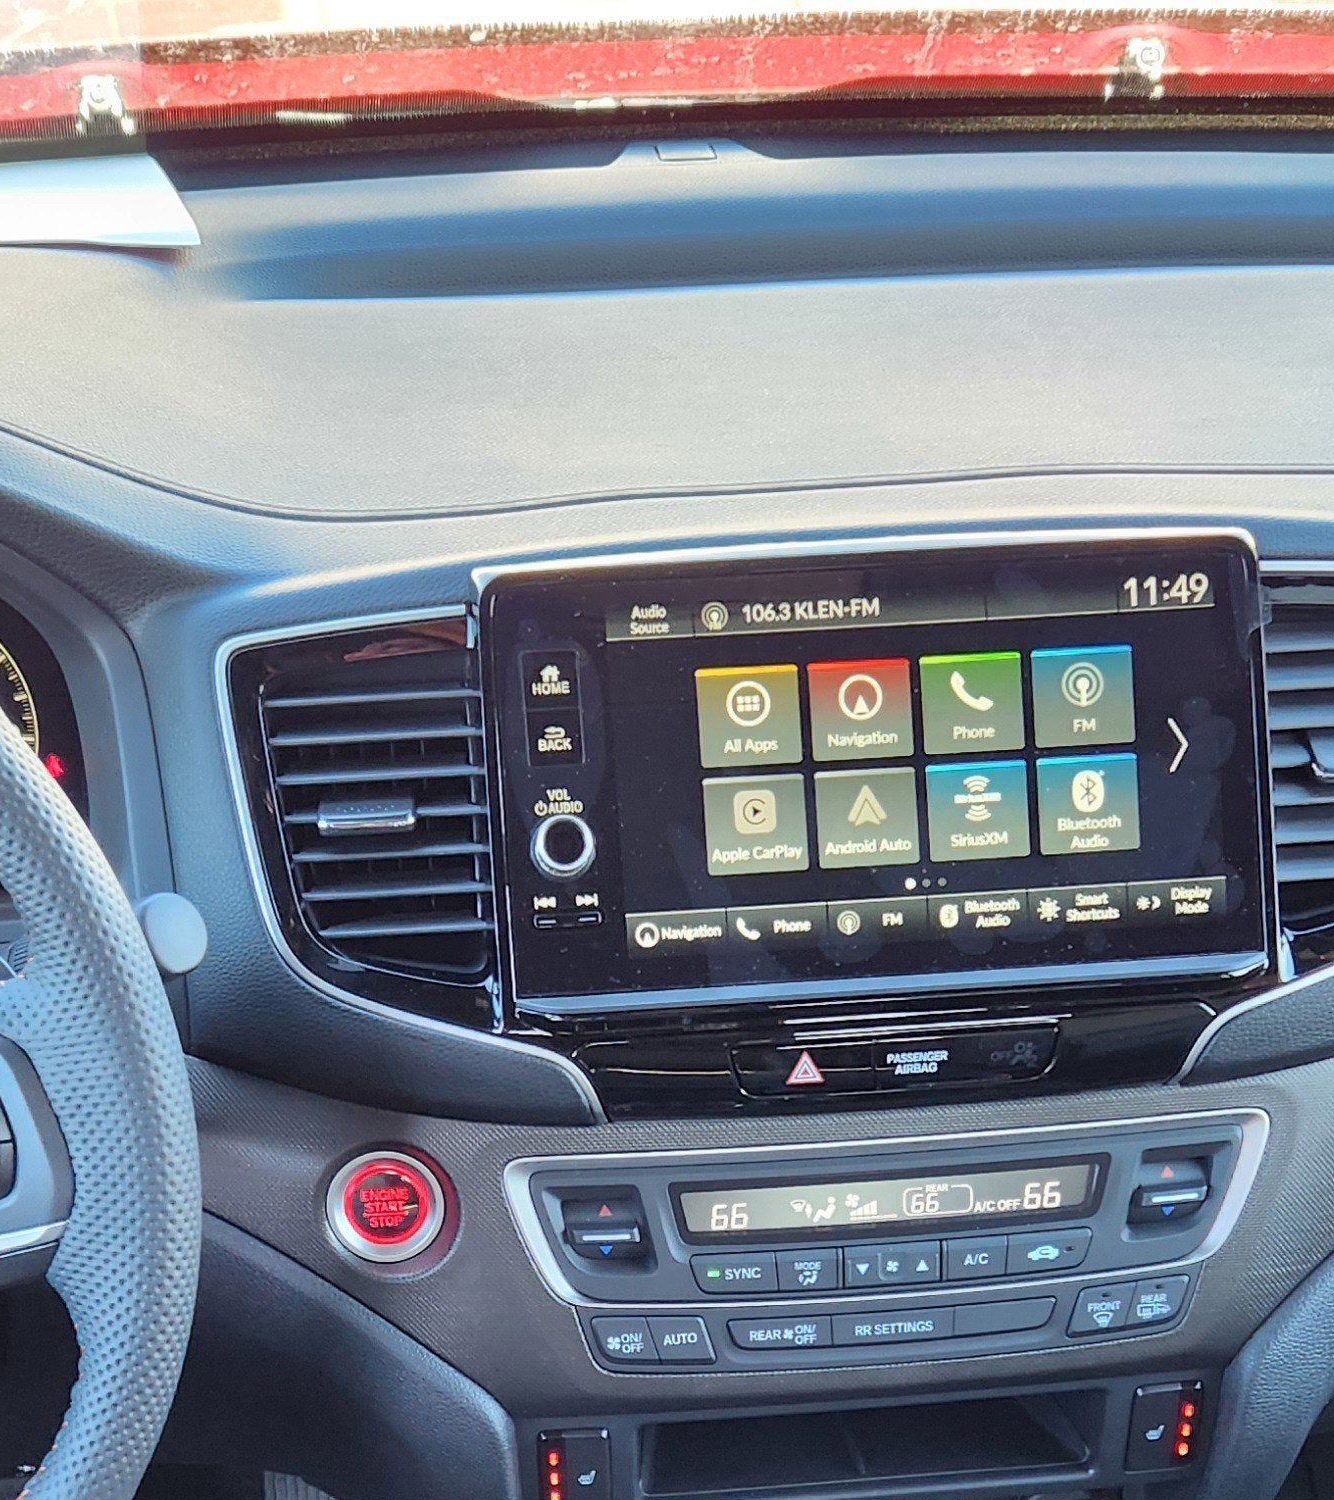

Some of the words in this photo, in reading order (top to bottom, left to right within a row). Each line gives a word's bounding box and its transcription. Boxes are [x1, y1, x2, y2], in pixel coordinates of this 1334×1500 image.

[1123, 574, 1209, 608] 11:49
[631, 605, 667, 620] Audio
[741, 603, 792, 623] 106.3
[794, 598, 880, 621] KLEN-FM
[630, 620, 670, 635] Source
[532, 681, 570, 696] HOME
[952, 725, 996, 740] Phone
[1073, 718, 1096, 732] FM
[538, 737, 572, 752] BACK
[723, 738, 742, 753] All
[744, 737, 779, 754] Apps
[827, 730, 898, 748] Navigation
[547, 789, 571, 802] VOL
[548, 801, 583, 815] AUDIO
[1057, 815, 1122, 832] Bluetooth
[825, 840, 877, 856] Android
[879, 838, 912, 853] Auto
[951, 831, 1008, 848] SiriusXM
[1070, 834, 1110, 850] Audio
[711, 847, 750, 864] Apple
[753, 844, 803, 862] CarPlay
[1075, 892, 1109, 907] Smart
[1170, 886, 1213, 901] Display
[964, 898, 1020, 914] Bluetooth
[1174, 900, 1210, 915] Mode
[882, 913, 903, 927] FM
[975, 914, 1011, 928] Audio
[1066, 906, 1121, 922] Shortcuts
[661, 924, 722, 941] Navigation
[773, 917, 812, 933] Phone
[886, 1050, 949, 1065] PASSENGER
[894, 1062, 938, 1076] AIRBAG
[360, 1187, 410, 1202] ENGINE
[925, 1183, 949, 1193] REAR
[910, 1193, 940, 1214] 66
[1023, 1182, 1061, 1210] 66
[365, 1201, 405, 1213] START
[973, 1199, 996, 1213] A/C
[997, 1198, 1021, 1212] OFF
[369, 1216, 404, 1228] STOP
[710, 1203, 748, 1232] 66
[794, 1261, 822, 1271] MODE
[963, 1252, 989, 1266] A/C
[724, 1267, 762, 1281] SYNC
[1141, 1293, 1167, 1304] REAR
[1087, 1301, 1122, 1313] FRONT
[749, 1328, 781, 1341] REAR
[795, 1323, 816, 1334] ON/
[854, 1324, 872, 1336] RR
[873, 1320, 934, 1335] SETTINGS
[621, 1333, 643, 1343] ON/
[663, 1331, 698, 1346] AUTO
[795, 1333, 817, 1345] OFF
[621, 1342, 644, 1354] OFF
